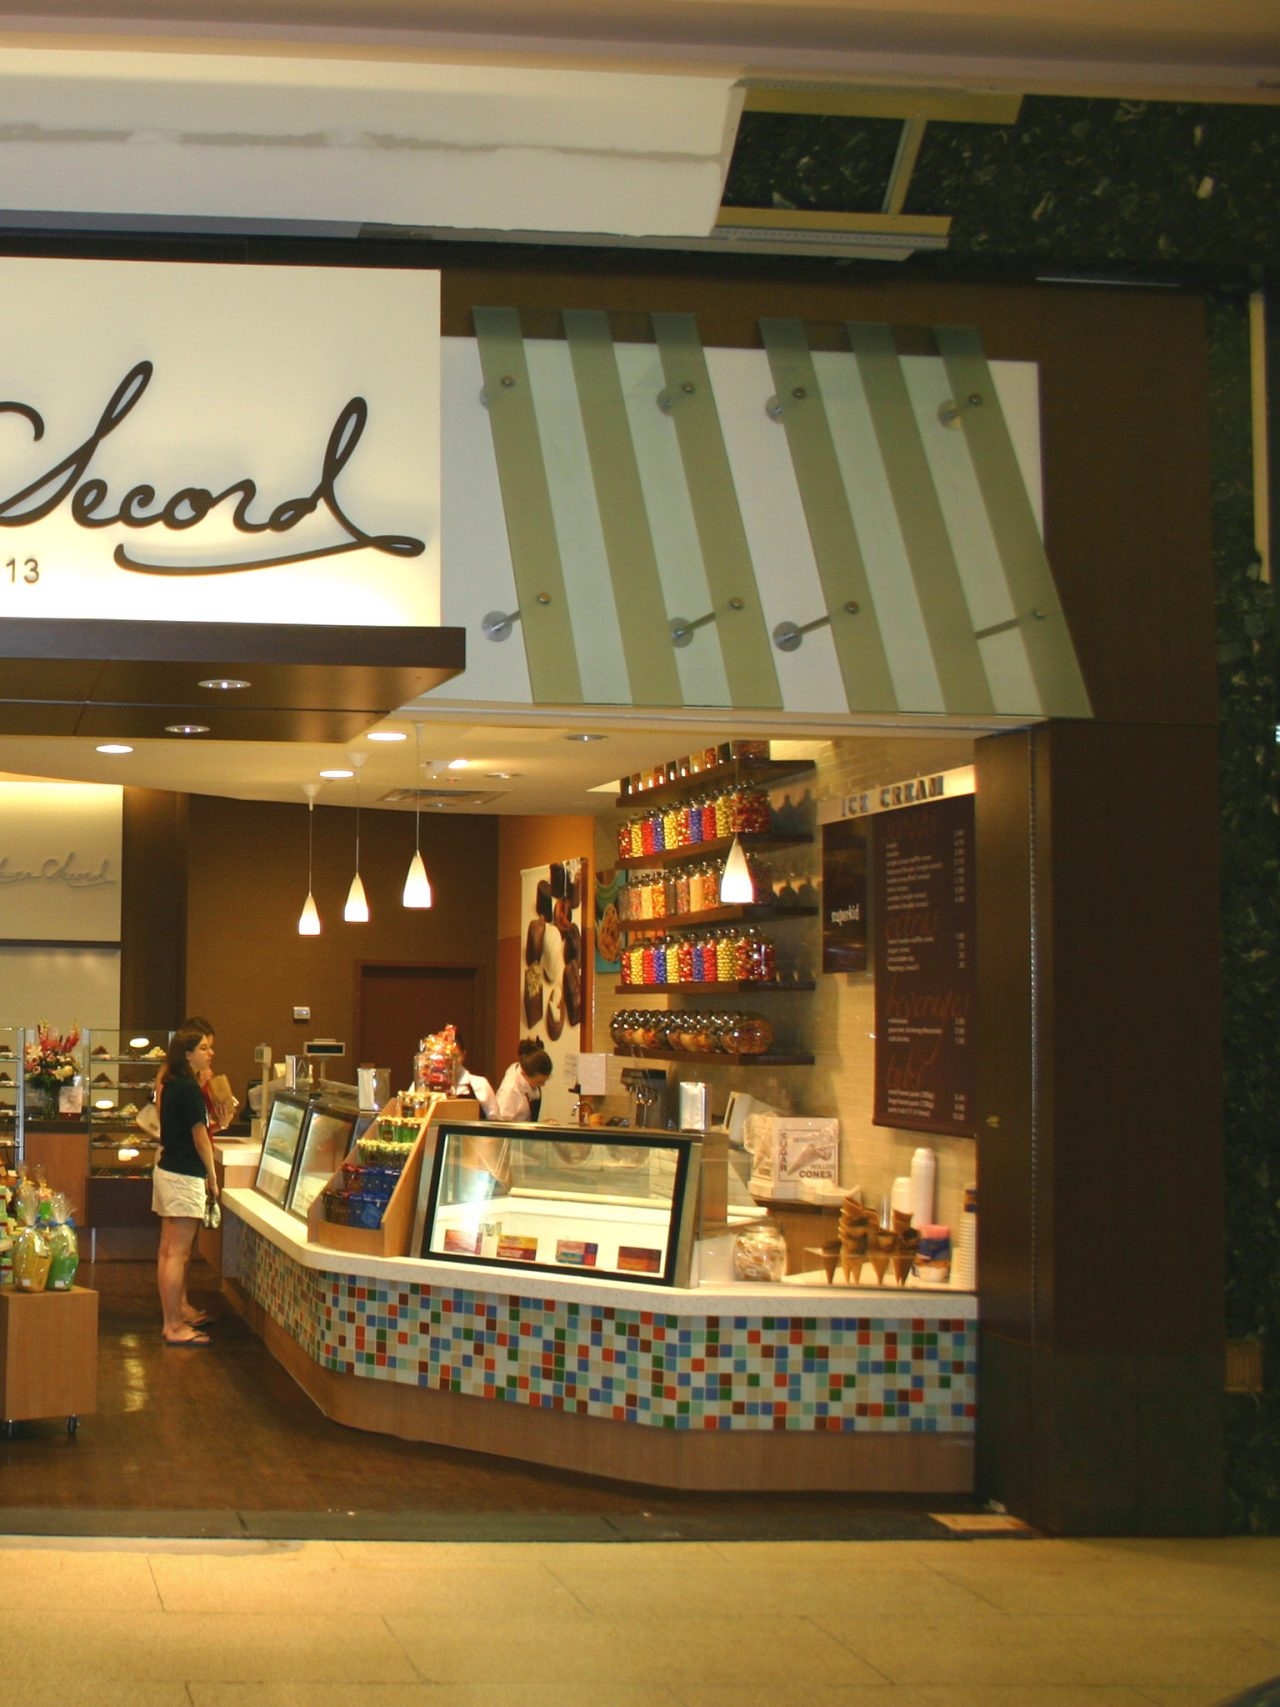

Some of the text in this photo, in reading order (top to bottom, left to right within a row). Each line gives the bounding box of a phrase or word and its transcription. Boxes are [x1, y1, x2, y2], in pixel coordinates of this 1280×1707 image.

[841, 776, 944, 817] ICE CREAM
[780, 1132, 788, 1172] SUGAR
[799, 1170, 833, 1179] CONES
